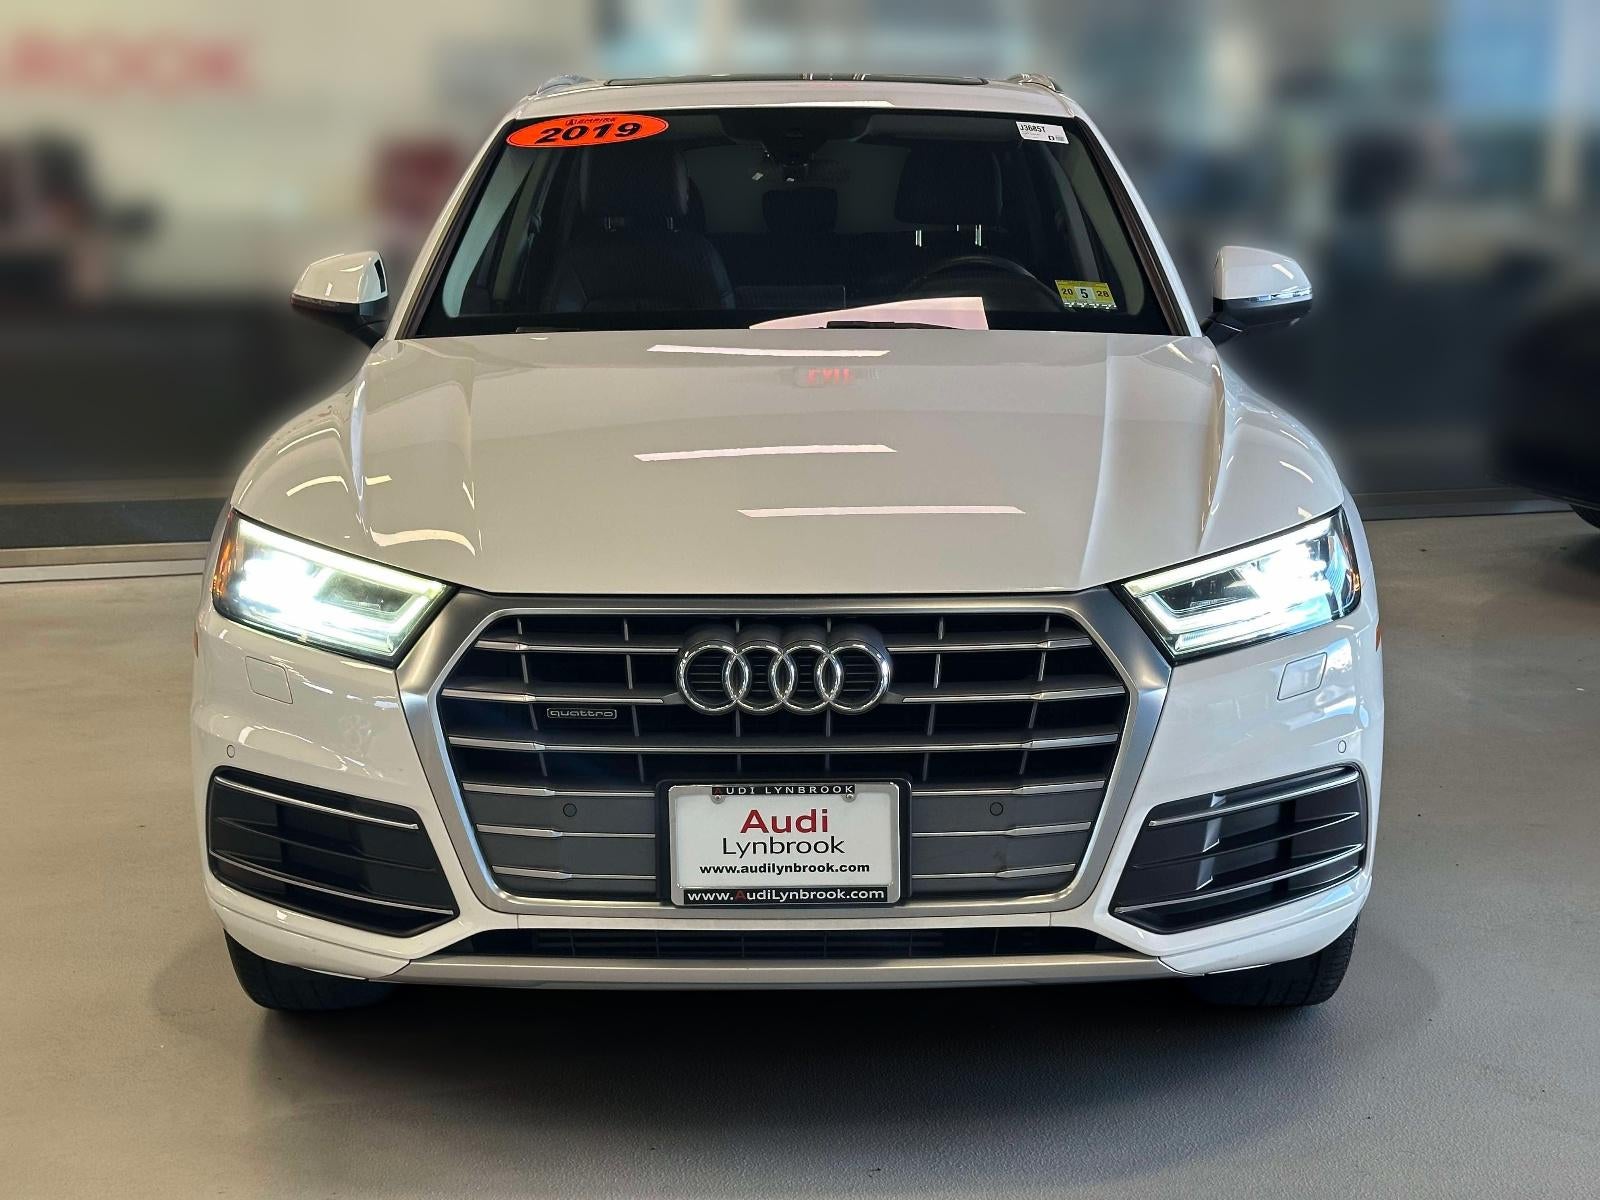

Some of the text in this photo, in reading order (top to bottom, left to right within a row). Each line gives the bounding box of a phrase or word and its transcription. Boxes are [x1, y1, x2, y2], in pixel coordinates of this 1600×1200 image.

[534, 122, 642, 145] 2019
[1080, 288, 1089, 299] 5
[714, 785, 854, 795] AUDI LYNBROOK
[740, 809, 829, 834] Audi
[722, 836, 845, 859] Lynbrook
[699, 862, 870, 876] www.audilynbrook.com
[687, 888, 885, 903] www.AudiLynbrook.com
